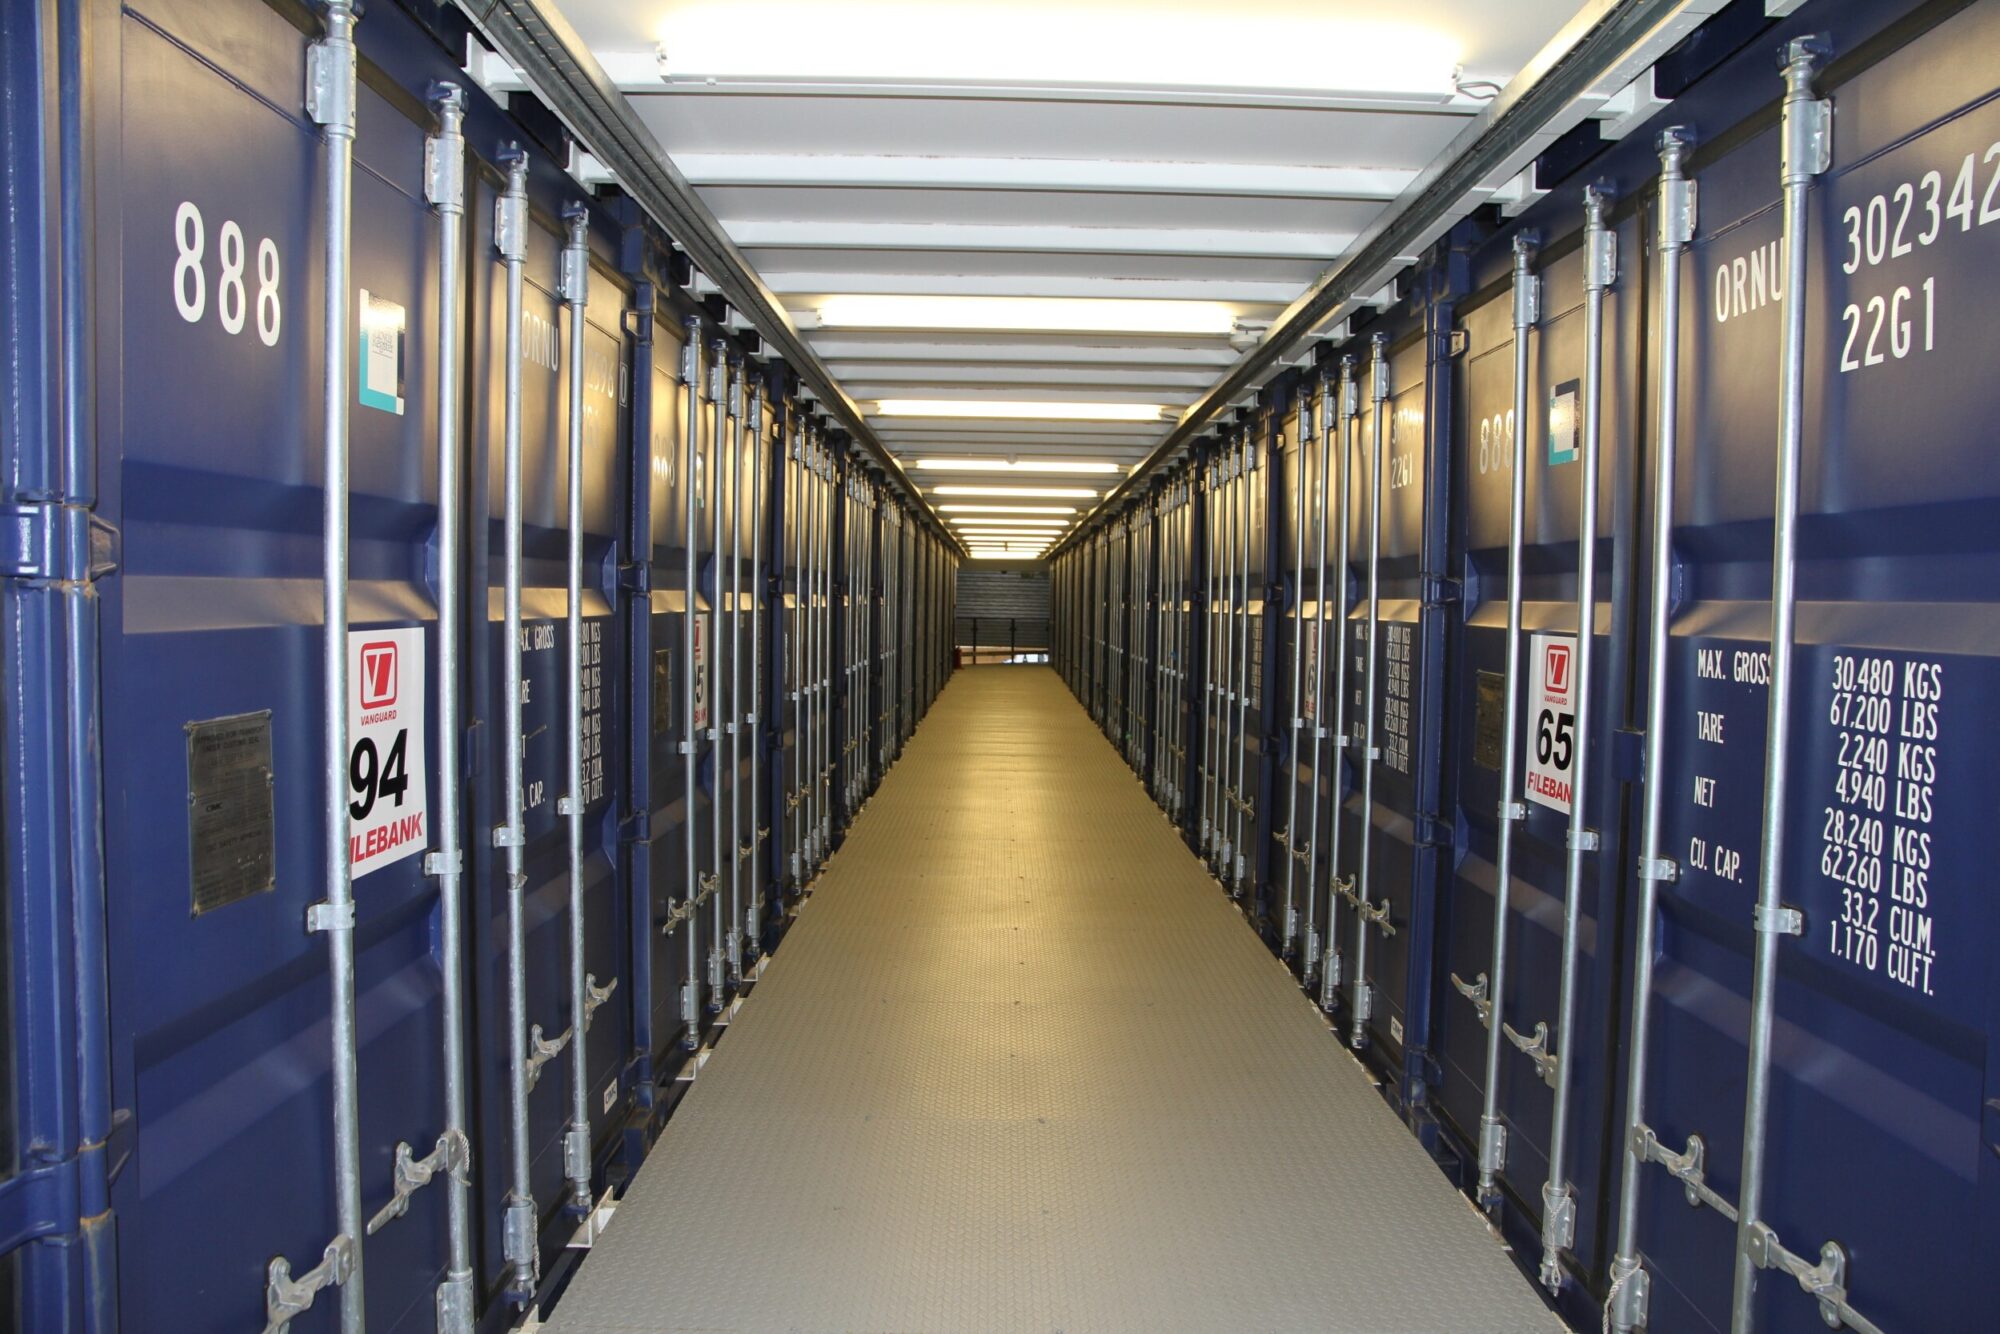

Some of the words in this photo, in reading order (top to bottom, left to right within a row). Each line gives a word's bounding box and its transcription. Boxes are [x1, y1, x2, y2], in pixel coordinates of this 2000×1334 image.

[1716, 237, 1784, 322] ORNU
[1842, 142, 2000, 275] 302342
[174, 201, 280, 347] 888
[522, 310, 559, 372] ORNU
[1840, 277, 1935, 373] 22G1
[534, 624, 555, 651] GROSS
[696, 665, 704, 704] 5
[1308, 664, 1315, 696] 6
[1697, 648, 1727, 680] MAX.
[1832, 655, 1894, 697] 30,480
[1903, 661, 1943, 701] KGS
[361, 710, 397, 727] VANGUARD
[1544, 694, 1568, 706] VANGUARD
[1830, 692, 1891, 734] 67,200
[1900, 700, 1939, 741] LBS
[1536, 708, 1575, 770] 65
[1697, 711, 1725, 744] TARE
[349, 728, 408, 821] 94
[1837, 731, 1888, 775] 2,240
[1897, 742, 1937, 784] KGS
[529, 780, 546, 808] CAP.
[1527, 771, 1572, 804] FILEBAN
[1693, 775, 1716, 808] NET
[1835, 768, 1886, 812] 4,940
[1895, 780, 1933, 823] LBS
[350, 811, 423, 865] ILEBANK
[1690, 836, 1708, 871] CU.
[1714, 845, 1742, 884] CAP.
[1823, 807, 1883, 856] 28,240
[1892, 825, 1931, 870] KGS
[1821, 843, 1881, 893] 62,260
[1891, 863, 1928, 909] LBS
[1841, 887, 1879, 934] 33.2
[1889, 905, 1936, 956] CU.M.
[1831, 920, 1878, 970] 1,170
[1887, 943, 1934, 996] CU.FT.
